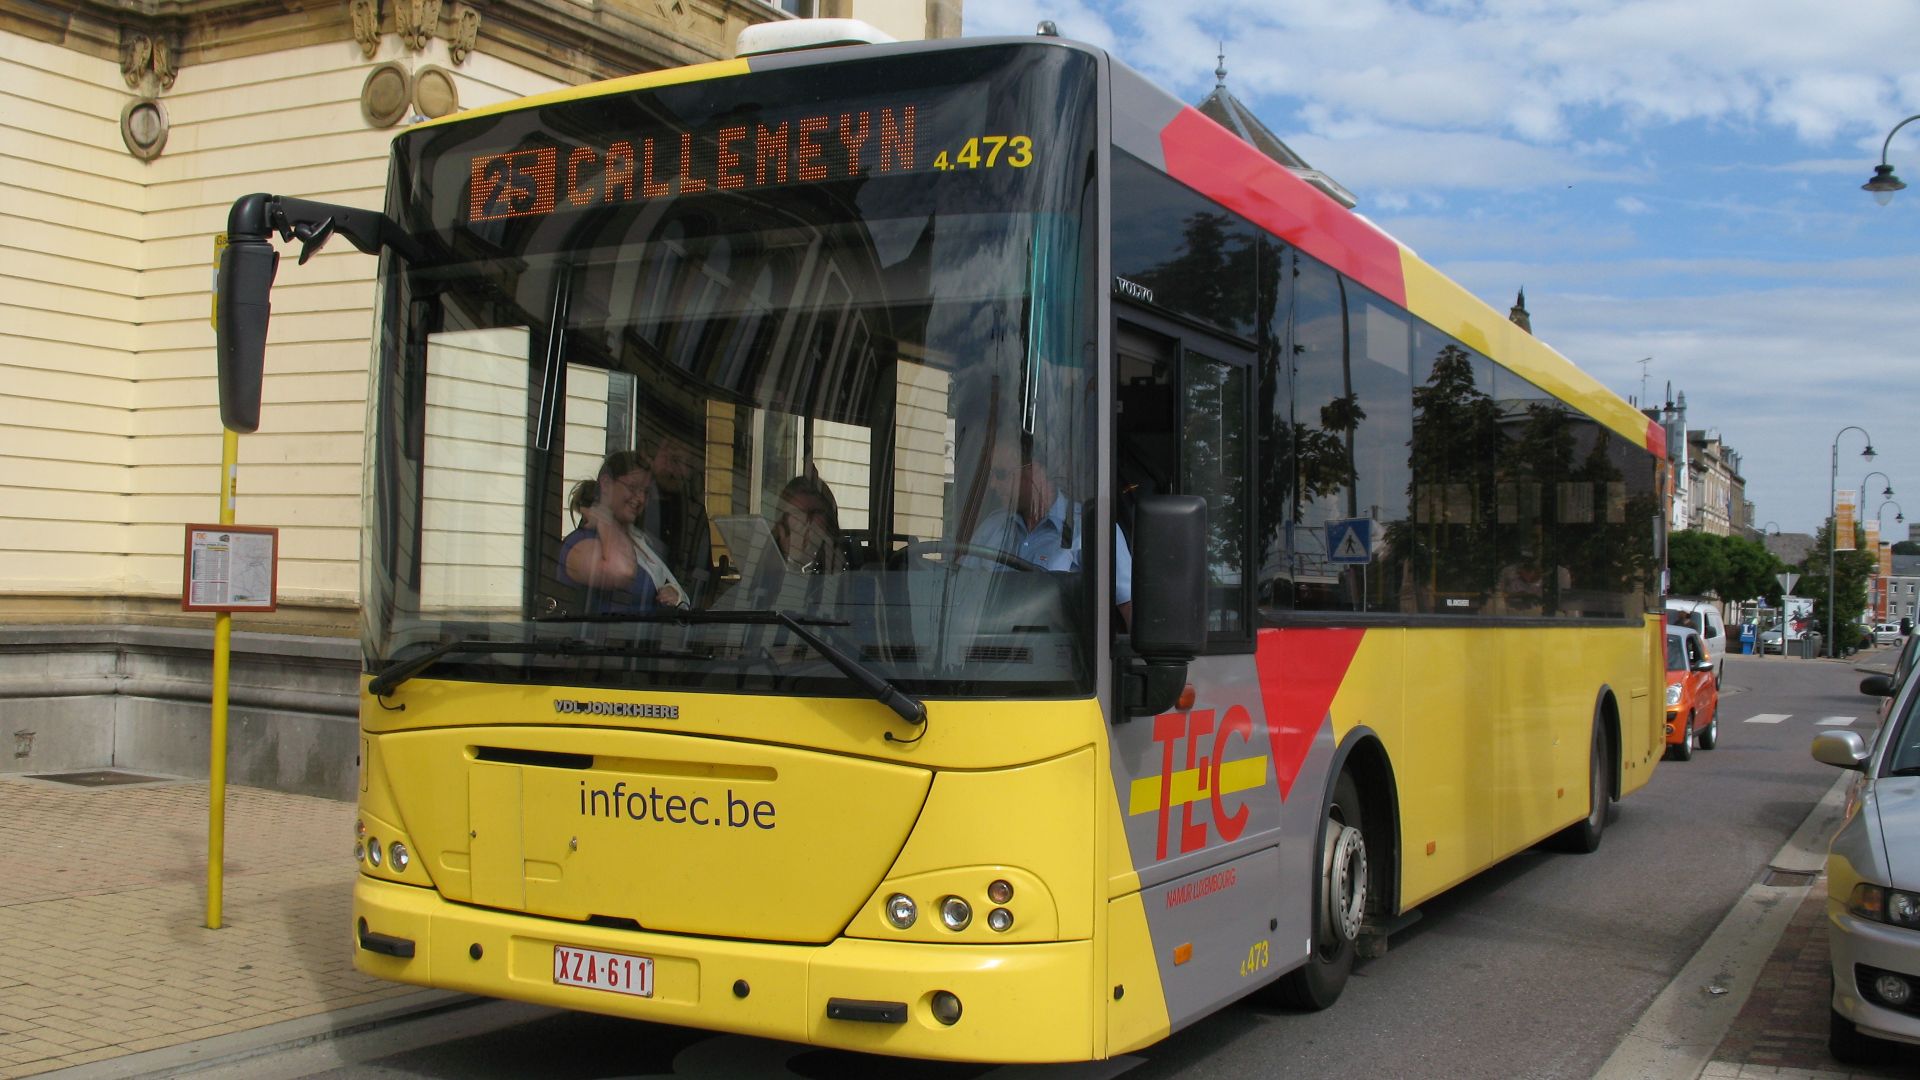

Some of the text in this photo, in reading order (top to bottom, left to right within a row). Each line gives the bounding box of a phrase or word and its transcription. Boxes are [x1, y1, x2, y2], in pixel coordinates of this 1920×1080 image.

[480, 105, 916, 217] 25 CALLEMEYN
[933, 135, 1033, 170] 4.473
[554, 699, 679, 719] VDL JONCKHEERE
[1153, 704, 1252, 861] TEC
[580, 781, 776, 830] infotec.be
[1166, 867, 1237, 909] NAMUR LUXEMBOURG
